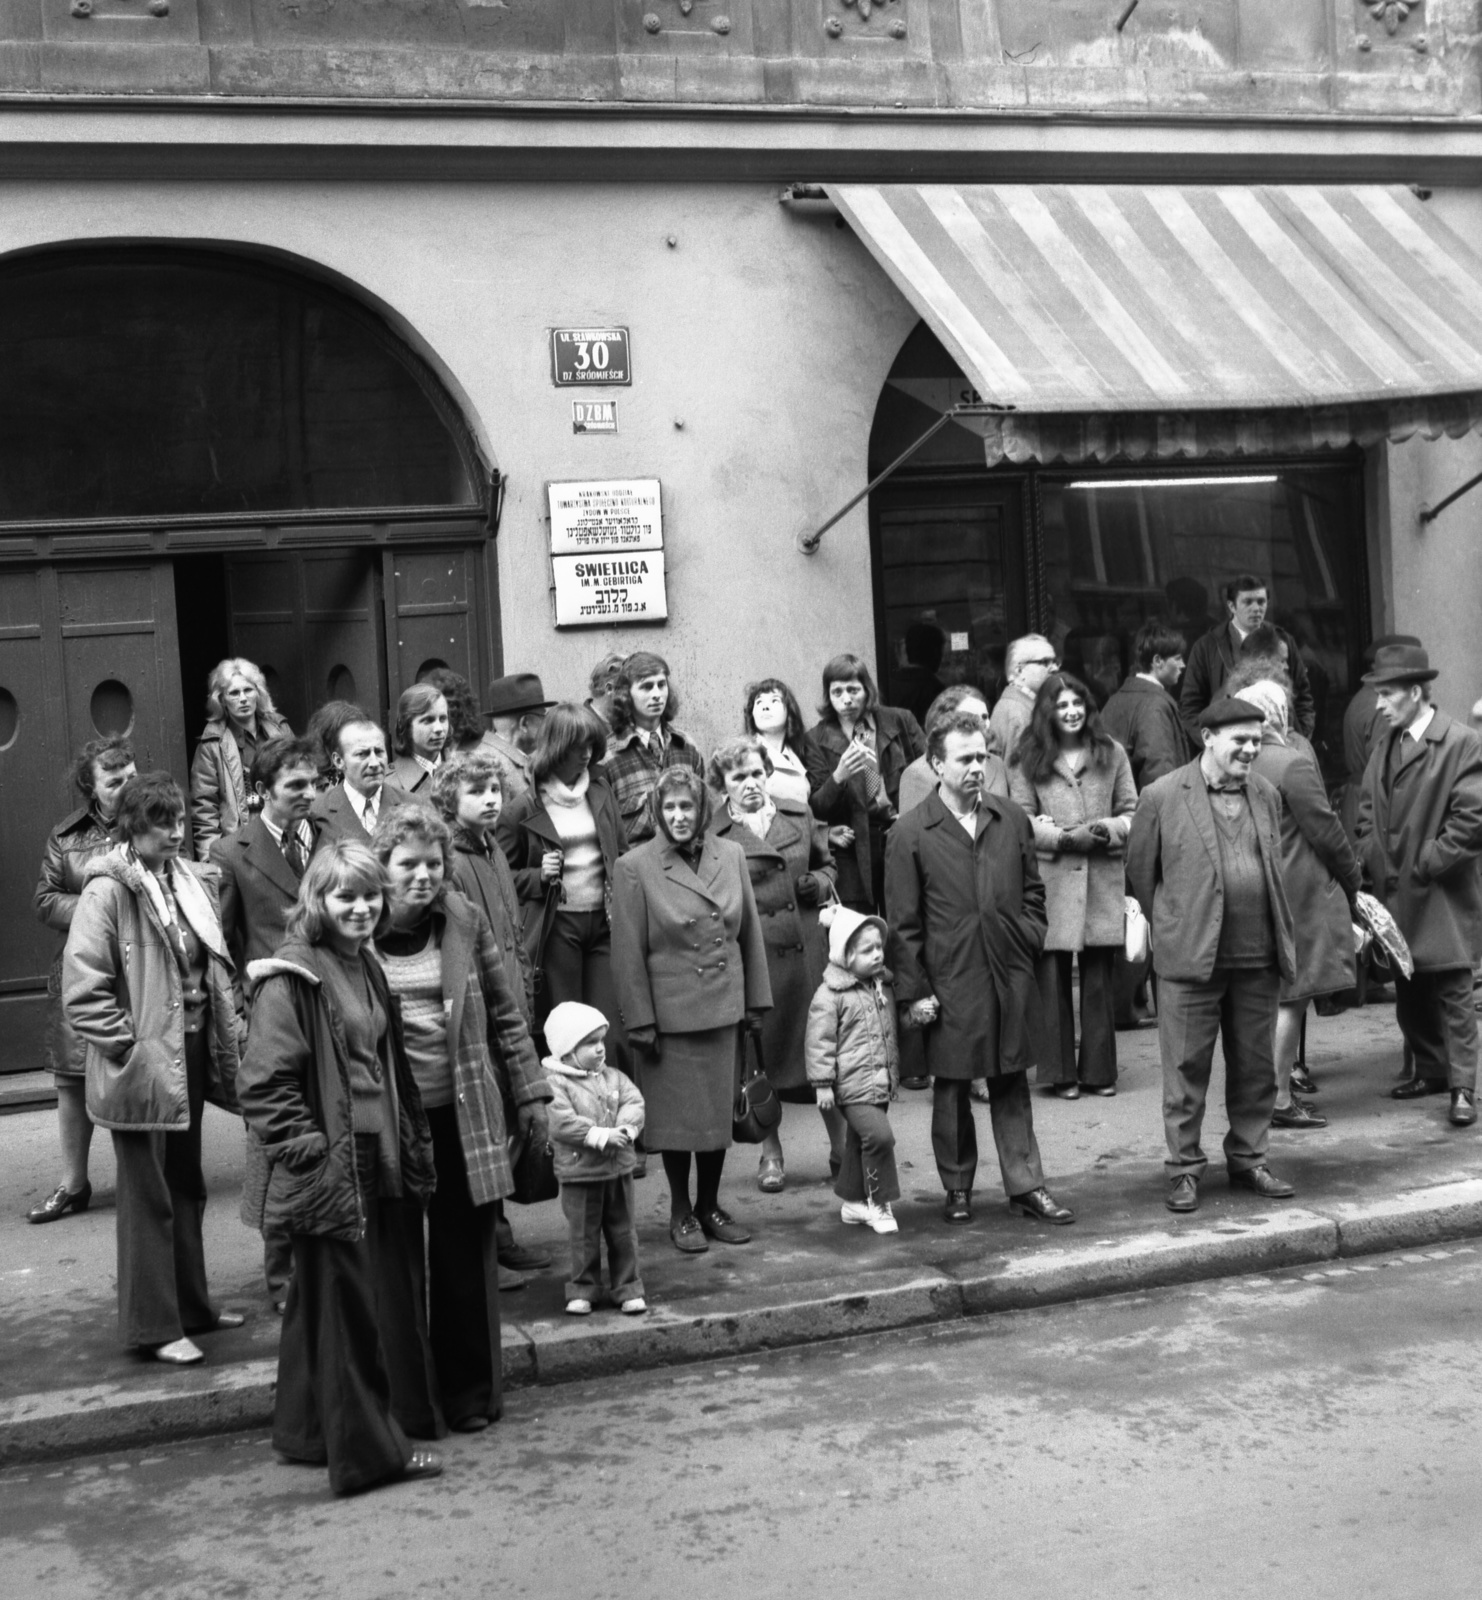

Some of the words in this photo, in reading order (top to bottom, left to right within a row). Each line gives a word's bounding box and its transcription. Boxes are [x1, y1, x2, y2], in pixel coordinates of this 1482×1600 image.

[573, 332, 622, 342] SŁAWKOWSKA
[574, 341, 609, 370] 30
[575, 368, 624, 380] ŚRÓDMIEŚCIE
[576, 404, 613, 421] DZBM
[557, 499, 591, 509] TOWARZYSTWA
[643, 524, 652, 534] פון
[595, 588, 628, 604] קלוב
